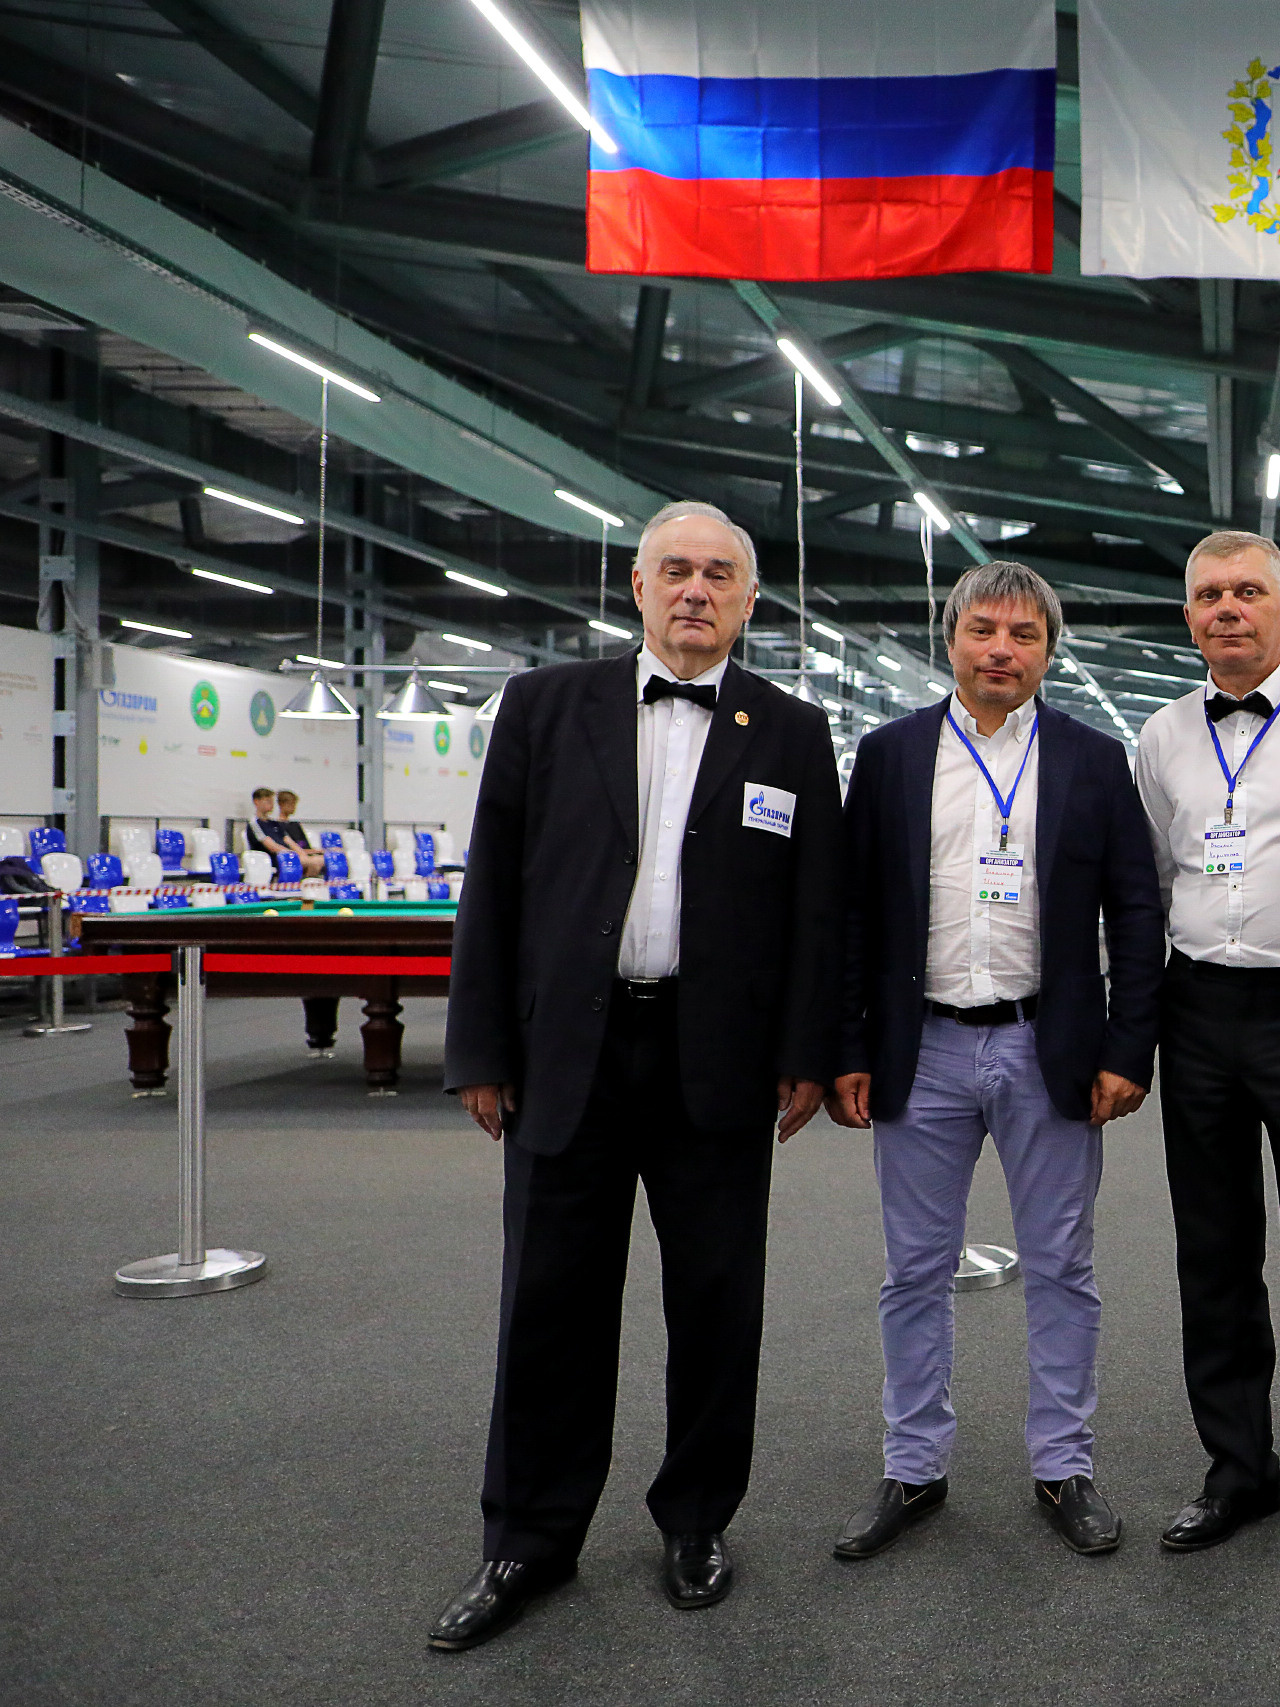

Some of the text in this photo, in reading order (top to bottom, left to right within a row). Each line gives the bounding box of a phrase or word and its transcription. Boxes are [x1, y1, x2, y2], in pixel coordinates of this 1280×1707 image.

[763, 807, 791, 824] ГАЗПРОМ
[1209, 830, 1241, 839] ОРГАНИЗАТОР
[985, 857, 1019, 866] ОРГАНИЗАТОР
